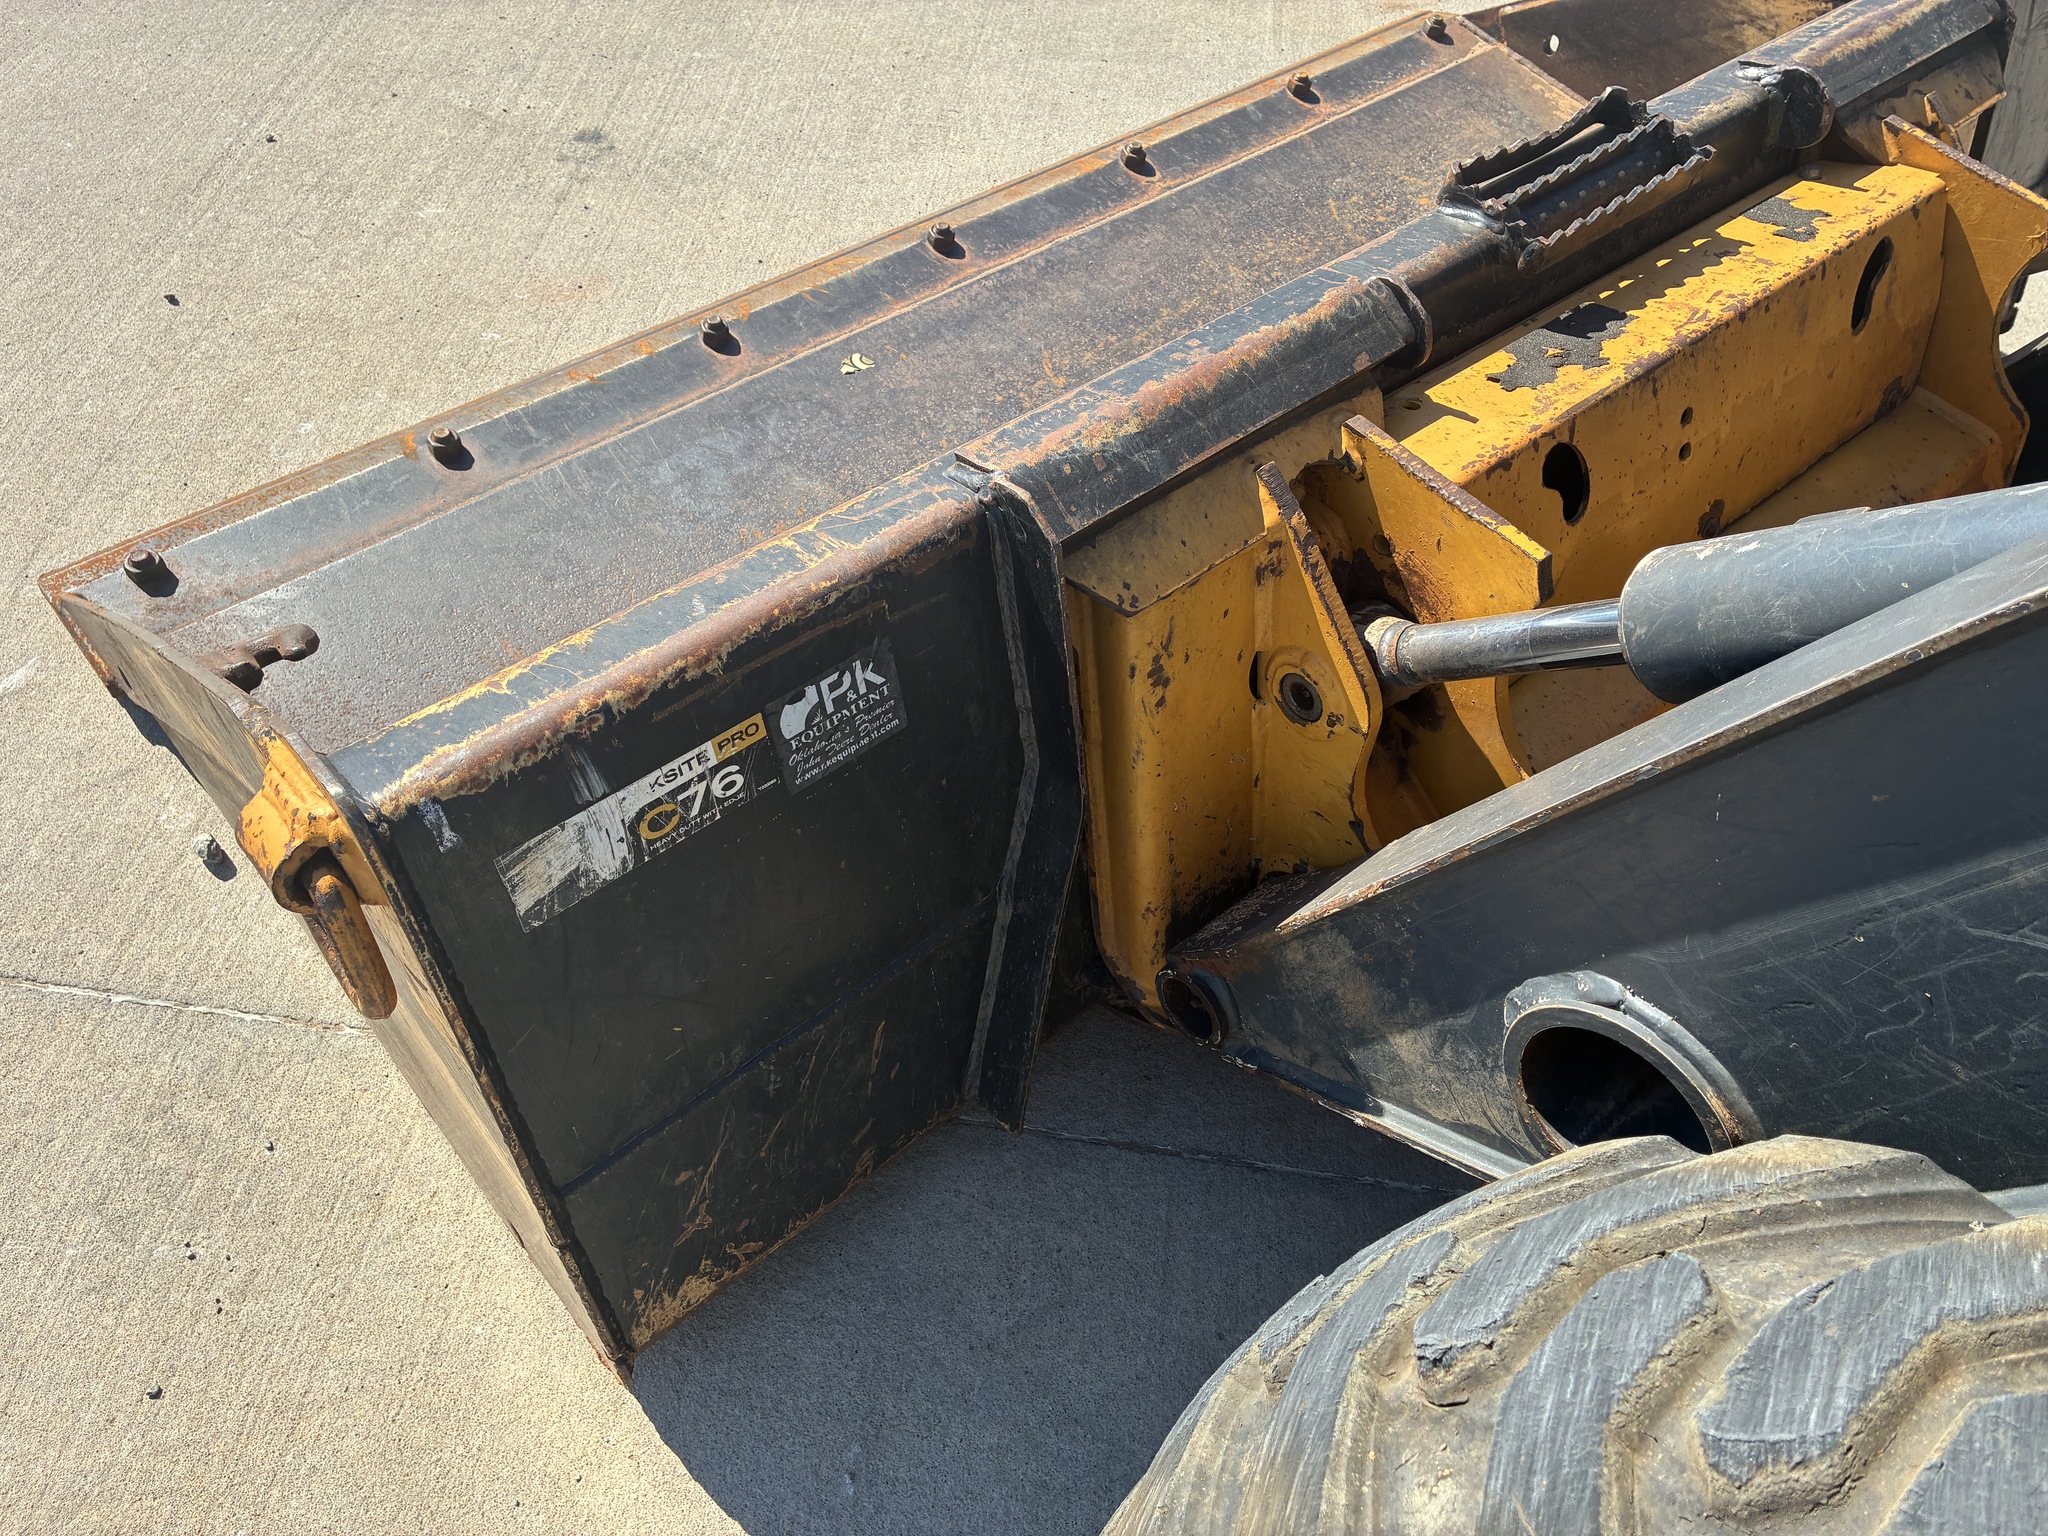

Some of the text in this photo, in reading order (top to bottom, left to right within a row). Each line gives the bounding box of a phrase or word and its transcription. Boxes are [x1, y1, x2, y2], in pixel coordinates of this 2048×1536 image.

[790, 684, 890, 750] EQUIPMENT
[855, 699, 895, 727] Premier
[717, 722, 760, 753] PRO
[796, 712, 894, 778] John Deere Dealer
[650, 831, 678, 850] HEAVY
[680, 817, 701, 834] DUTY
[703, 804, 723, 820] WITH
